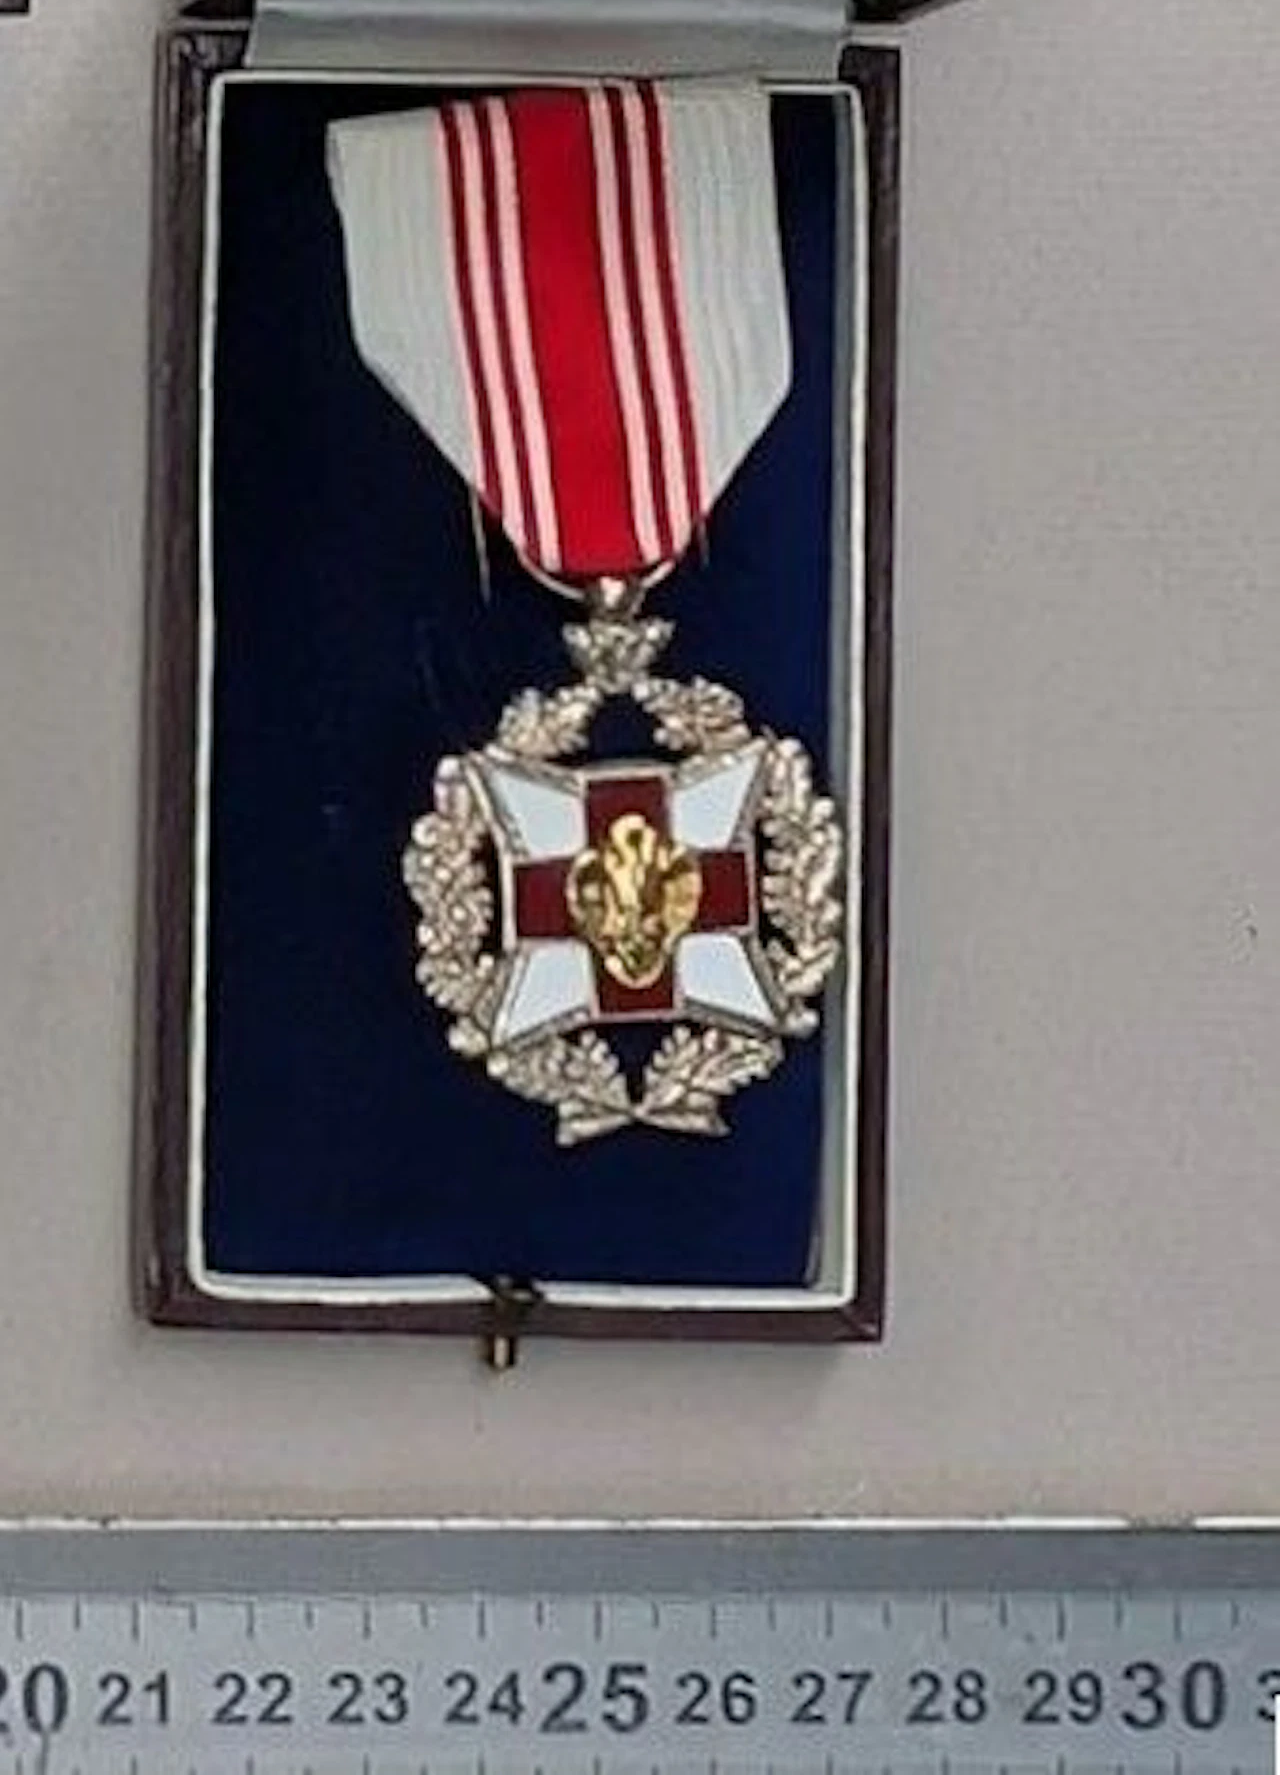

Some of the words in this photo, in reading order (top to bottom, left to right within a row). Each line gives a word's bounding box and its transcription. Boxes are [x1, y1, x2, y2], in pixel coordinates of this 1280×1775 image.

[98, 1671, 168, 1725] 21
[212, 1672, 293, 1725] 22
[328, 1672, 408, 1725] 23
[445, 1671, 525, 1724] 24
[542, 1663, 648, 1733] 25
[676, 1671, 756, 1725] 26
[791, 1671, 872, 1724] 27
[907, 1670, 987, 1724] 28
[1024, 1670, 1103, 1724] 29
[1121, 1662, 1225, 1730] 30
